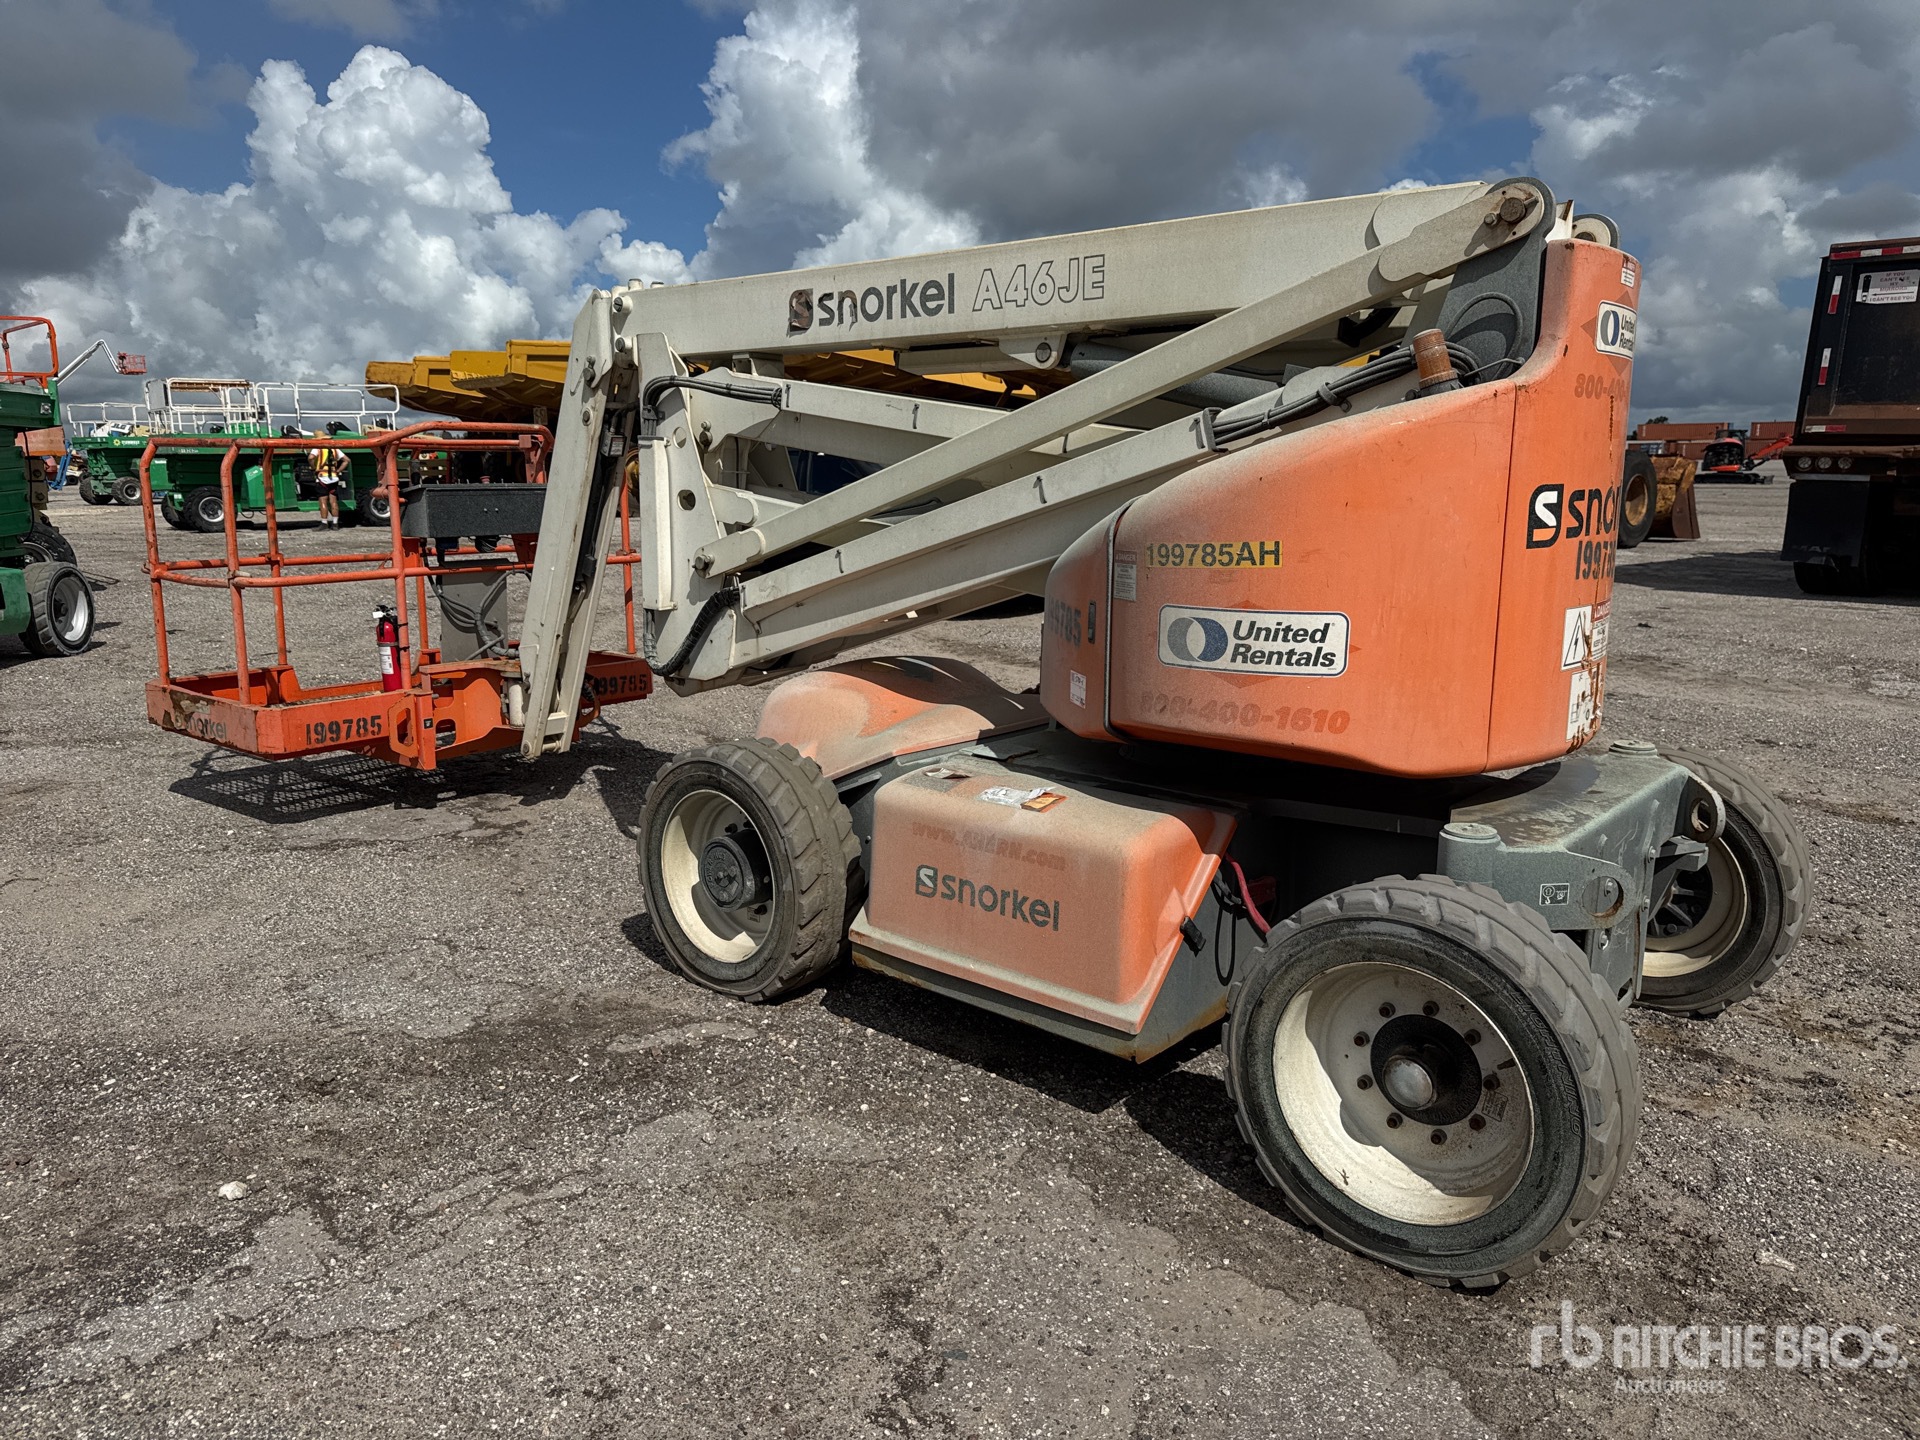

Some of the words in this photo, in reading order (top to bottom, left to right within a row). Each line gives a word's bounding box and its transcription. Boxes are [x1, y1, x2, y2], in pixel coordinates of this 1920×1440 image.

[818, 273, 955, 329] snorkel
[972, 254, 1106, 313] A46JE
[1146, 541, 1280, 566] 199785AH
[1232, 620, 1330, 644] United
[1230, 643, 1337, 668] Rentals
[596, 674, 647, 696] 99785
[186, 716, 227, 740] norkel
[306, 715, 382, 746] 199785
[940, 873, 1060, 931] snorkel
